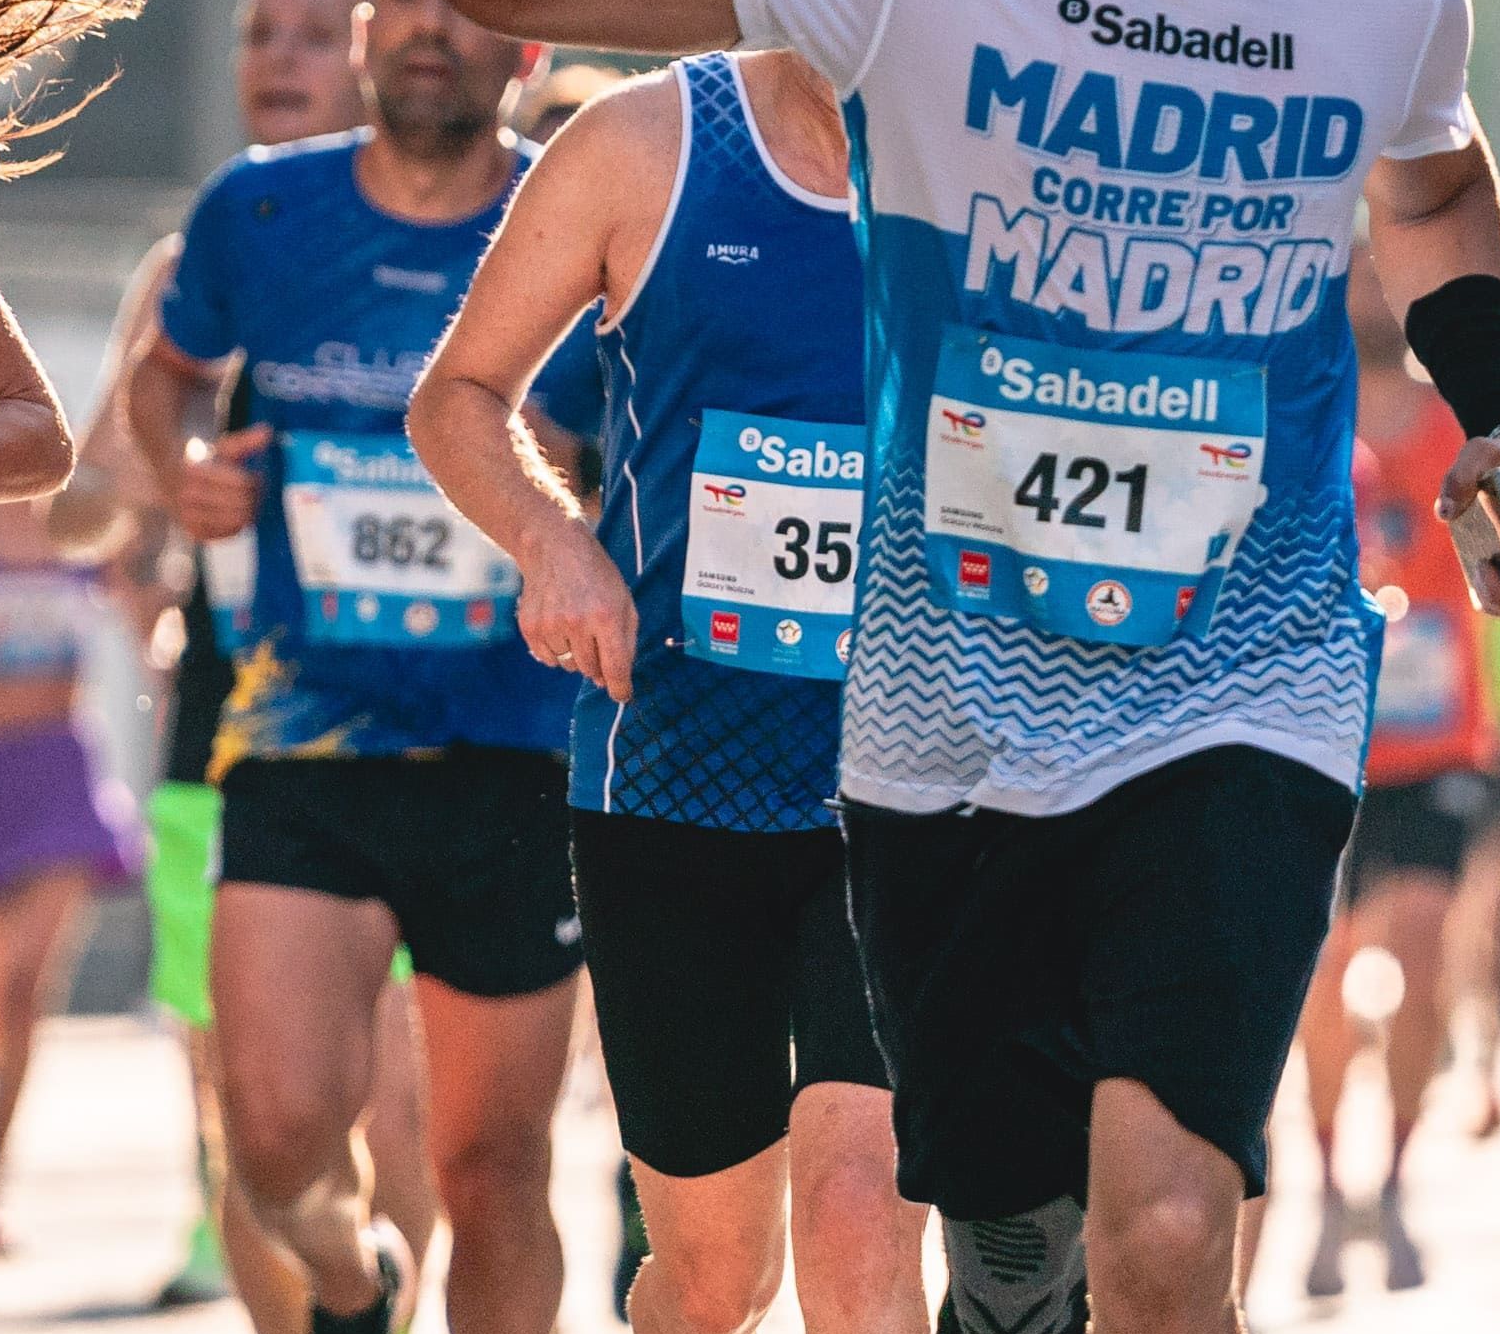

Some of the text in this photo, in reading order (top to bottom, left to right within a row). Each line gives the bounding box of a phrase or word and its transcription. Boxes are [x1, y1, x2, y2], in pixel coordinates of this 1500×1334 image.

[1091, 4, 1293, 69] Sabadell
[965, 43, 1362, 181] MADRID
[1032, 166, 1295, 231] CORRE POR
[706, 243, 759, 260] AMURA
[963, 192, 1333, 335] MADRID
[1000, 358, 1218, 422] Sabadell
[1014, 452, 1148, 533] 421
[353, 515, 451, 569] 862
[773, 516, 859, 585] 35
